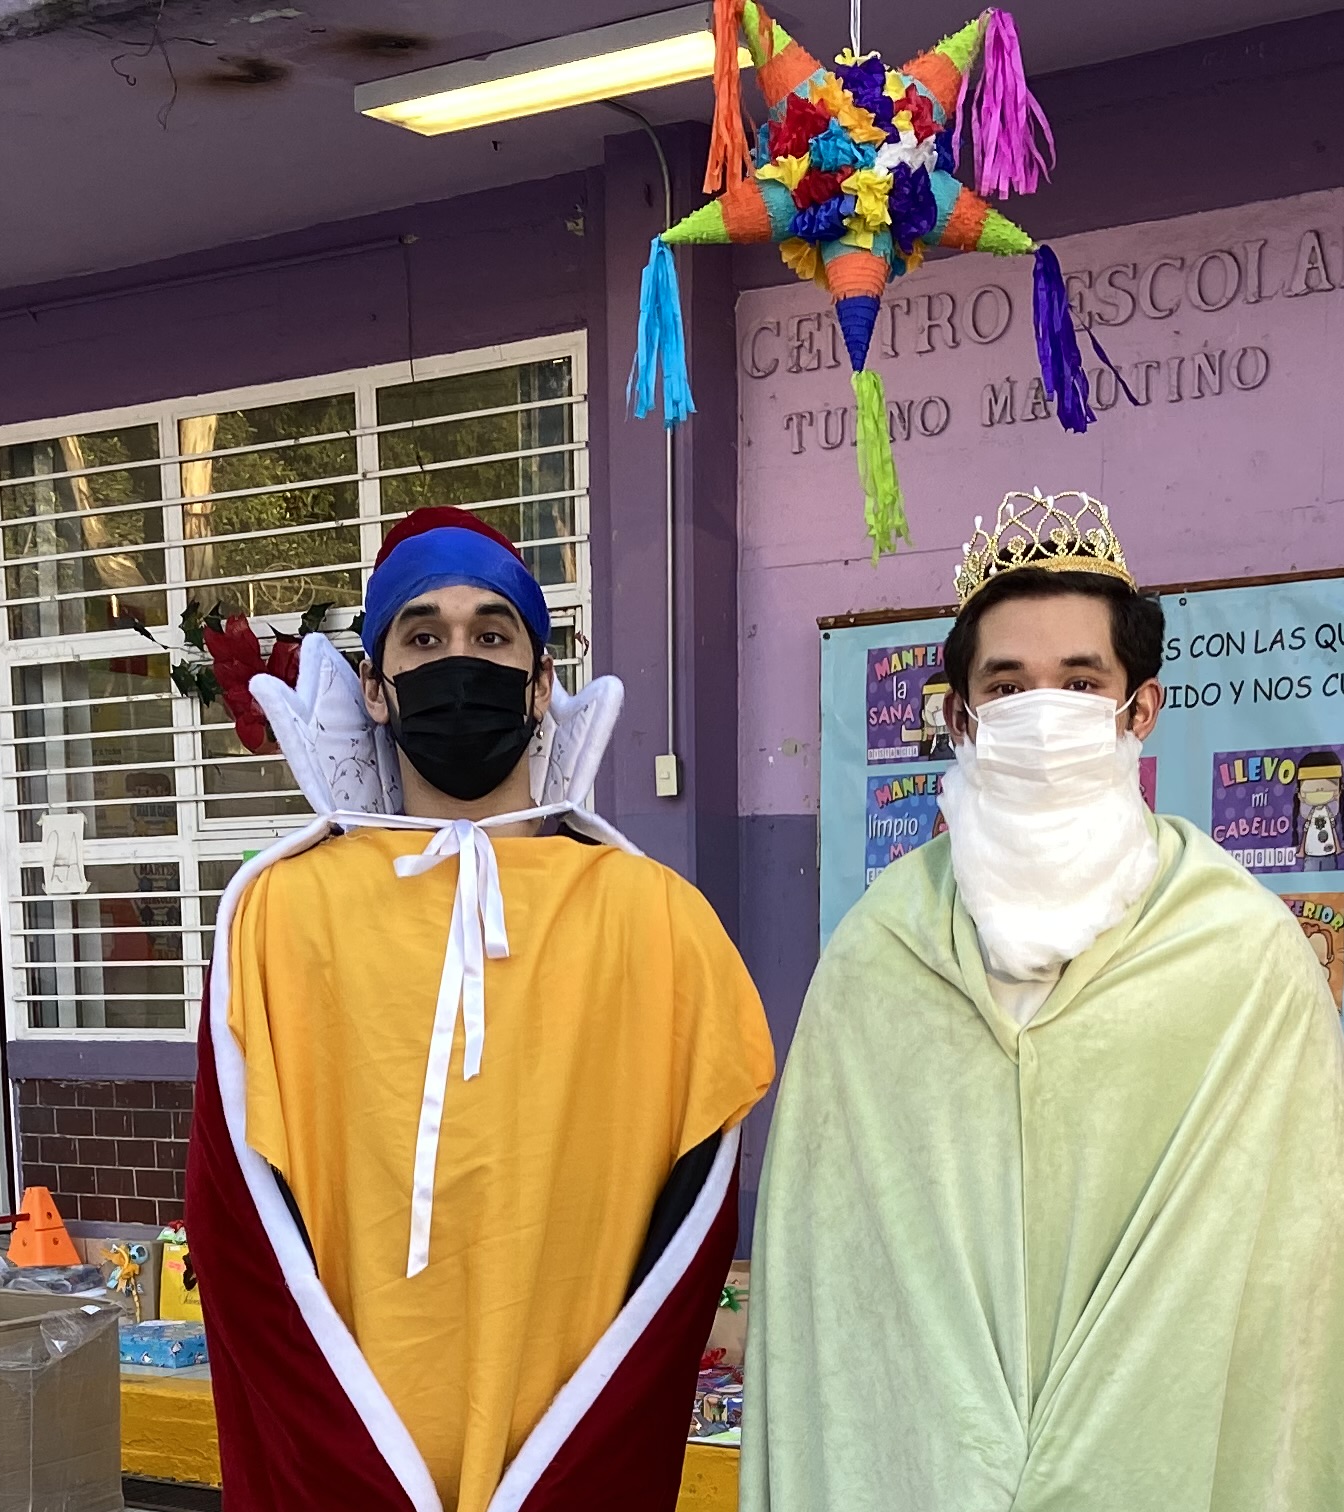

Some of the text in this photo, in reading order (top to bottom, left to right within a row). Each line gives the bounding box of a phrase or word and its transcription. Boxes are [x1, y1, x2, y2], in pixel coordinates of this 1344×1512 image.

[783, 346, 1269, 454] TUNO MAUTINO
[1189, 631, 1246, 659] CON
[1253, 627, 1307, 655] LAS
[893, 675, 908, 702] la
[1229, 680, 1245, 705] Y
[1253, 675, 1312, 704] NOS
[868, 703, 915, 725] SANA
[1219, 756, 1297, 788] LLEVO
[1251, 788, 1269, 808] mi
[1212, 815, 1291, 844] CABELLO
[1233, 849, 1295, 866] COGIDO
